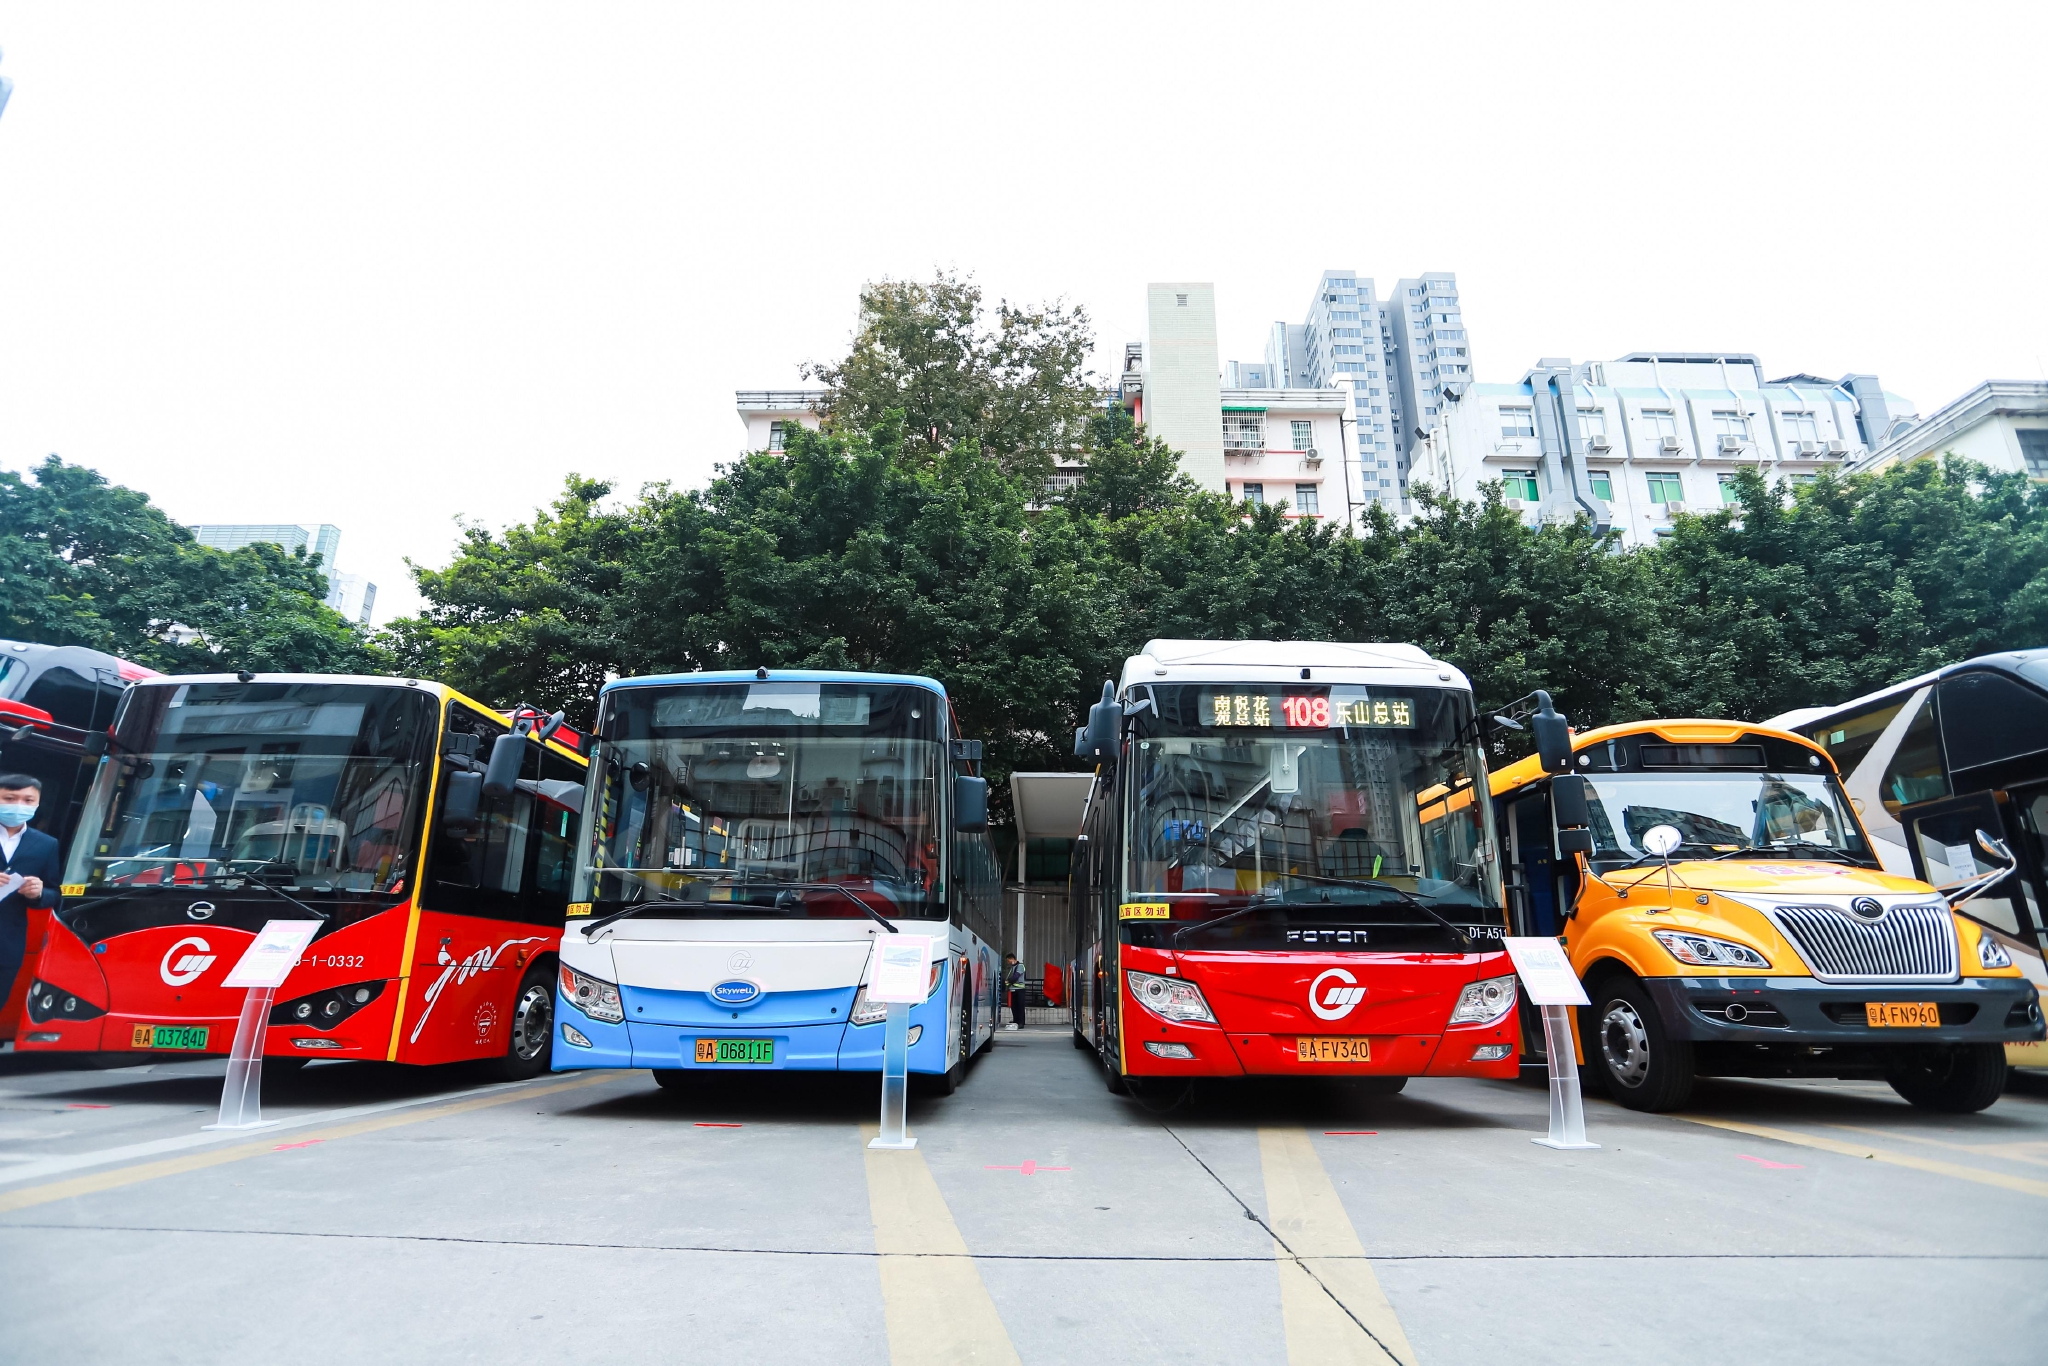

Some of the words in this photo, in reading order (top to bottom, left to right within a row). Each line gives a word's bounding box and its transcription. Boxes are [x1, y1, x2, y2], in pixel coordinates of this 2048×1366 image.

[1213, 695, 1270, 711] 南悦花
[1214, 711, 1271, 727] 苑总站
[1282, 696, 1331, 728] 108
[1335, 701, 1411, 726] 东山总站
[1286, 930, 1369, 943] FOTON
